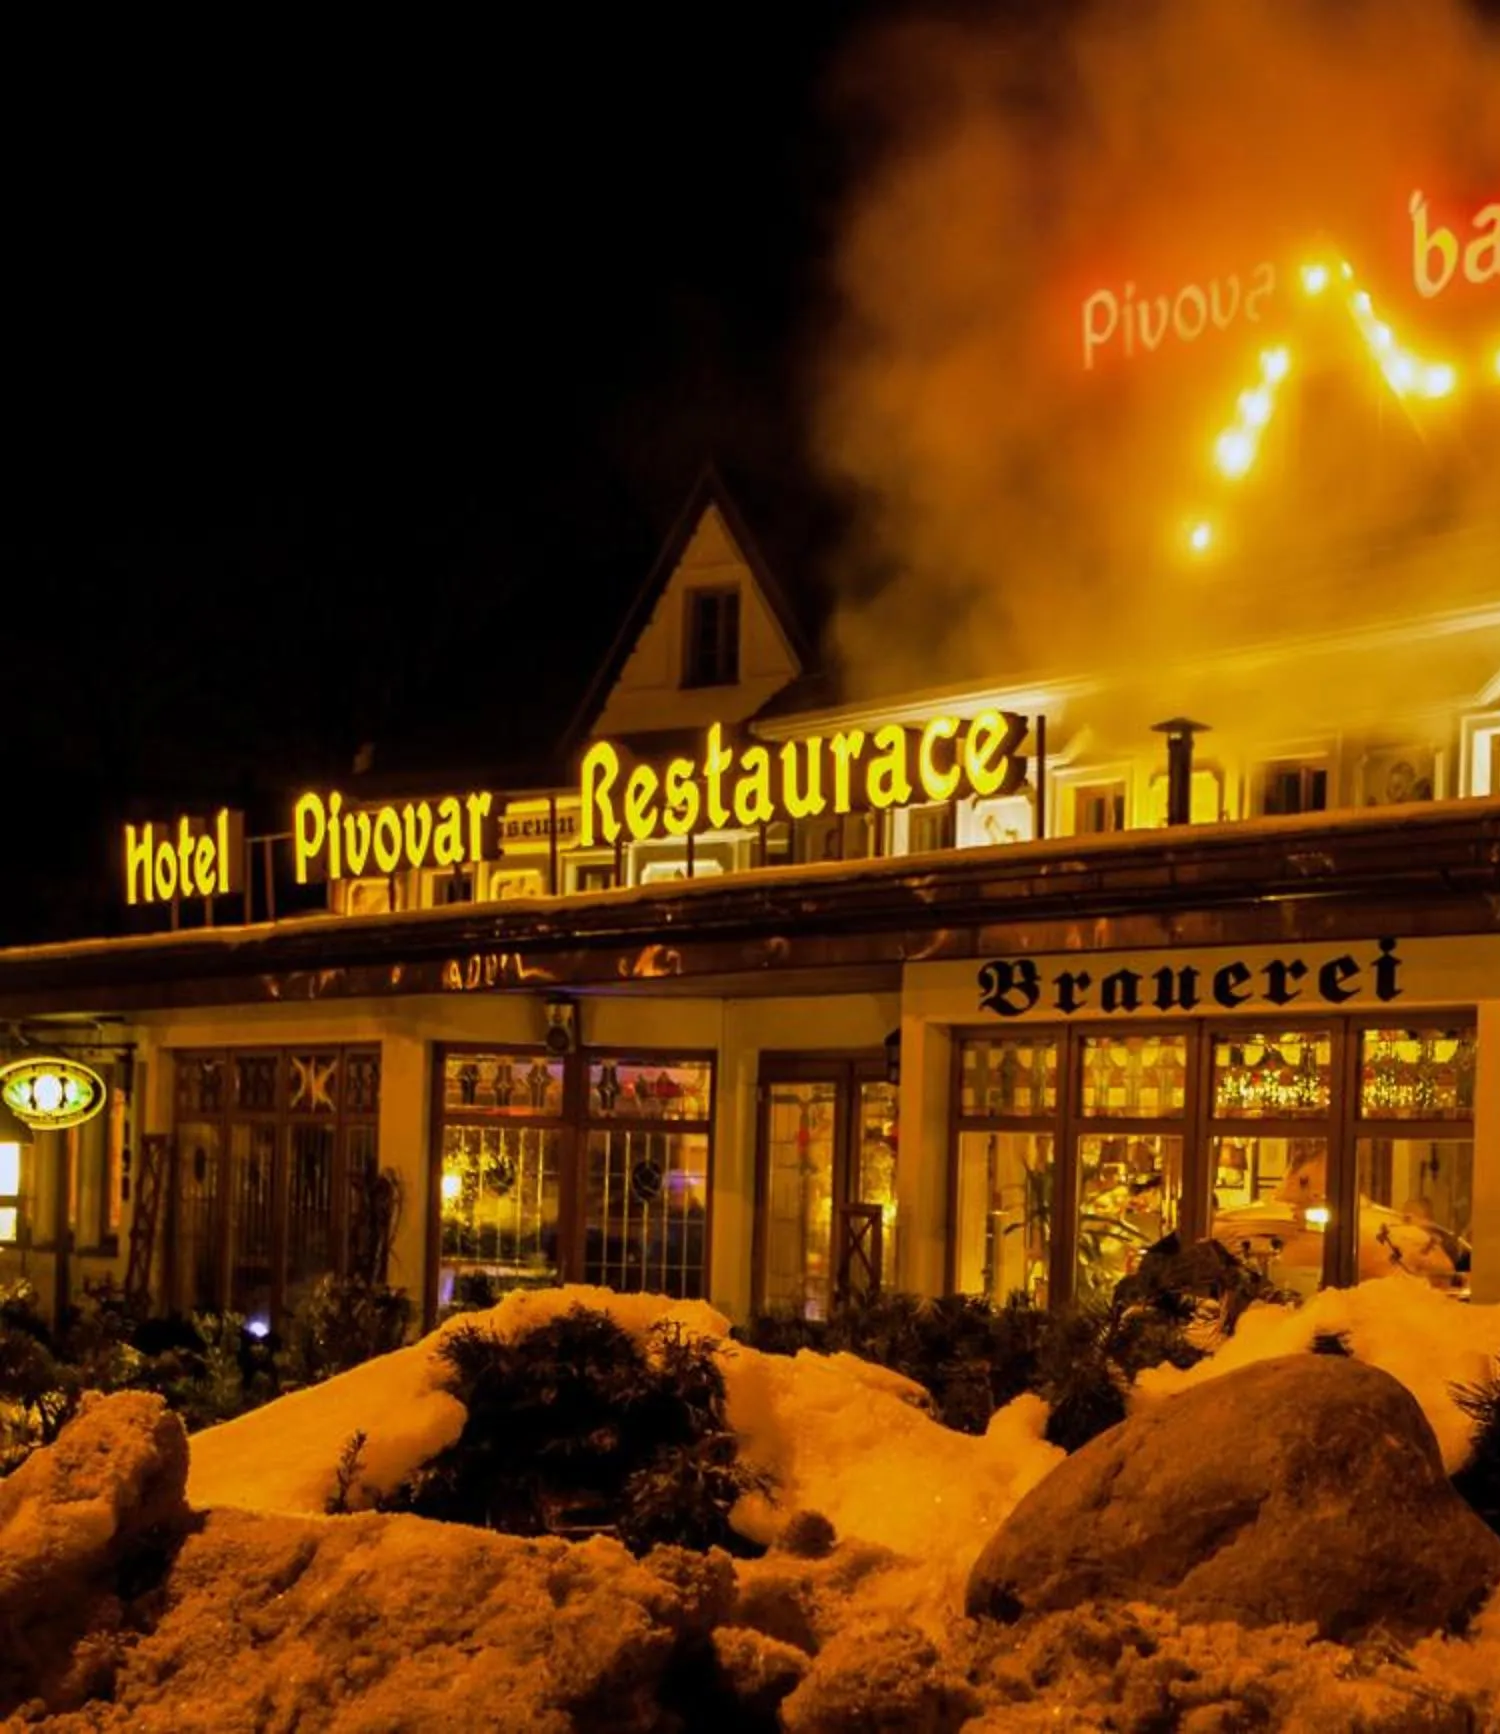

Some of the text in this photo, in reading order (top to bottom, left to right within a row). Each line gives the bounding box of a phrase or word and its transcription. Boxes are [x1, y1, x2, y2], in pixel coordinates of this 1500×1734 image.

[1081, 261, 1276, 370] Pivova
[125, 708, 1009, 905] Hotel Pivovar Restaurace
[977, 936, 1403, 1017] Brauerei
